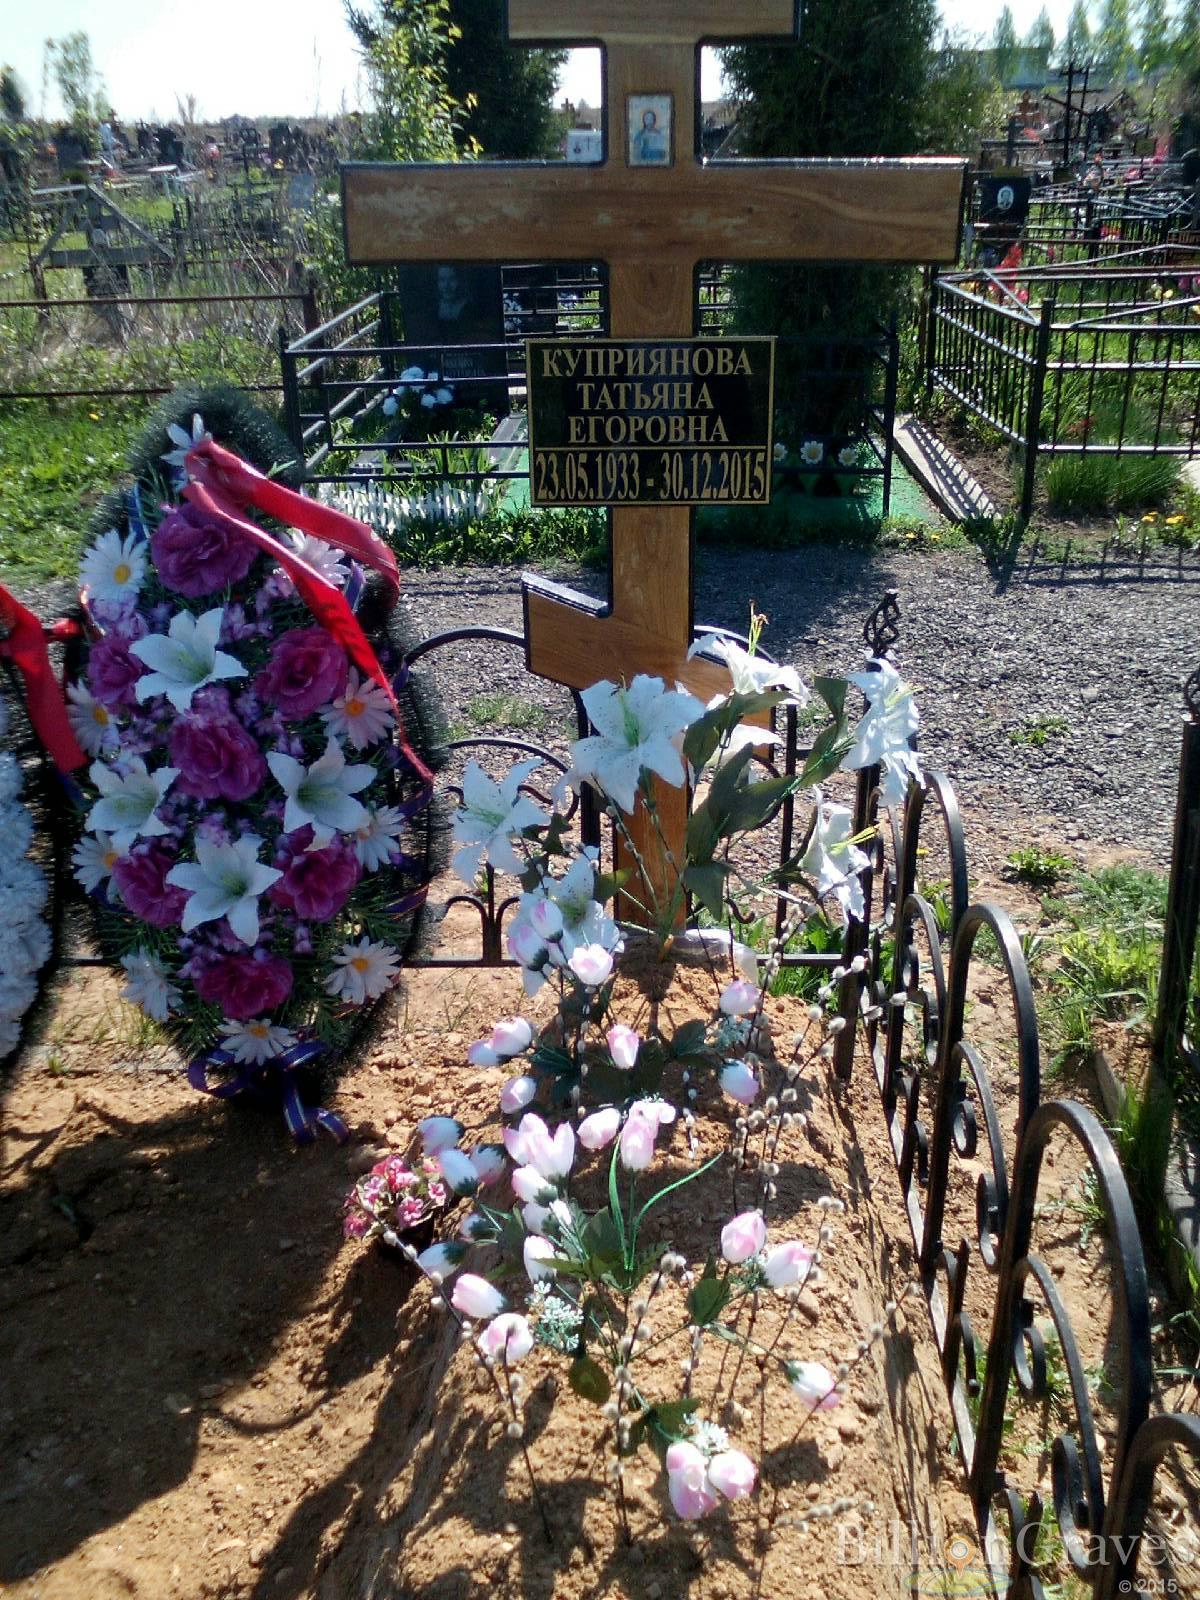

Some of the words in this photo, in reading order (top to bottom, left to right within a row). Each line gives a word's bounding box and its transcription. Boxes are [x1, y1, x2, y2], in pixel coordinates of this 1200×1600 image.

[542, 347, 753, 377] КУПРИЯНОВА
[576, 382, 715, 410] ТАТЬЯНА
[568, 415, 729, 444] ЕГОРОВНА
[535, 452, 640, 500] 23.05.1933
[660, 451, 766, 500] 30.12.2015
